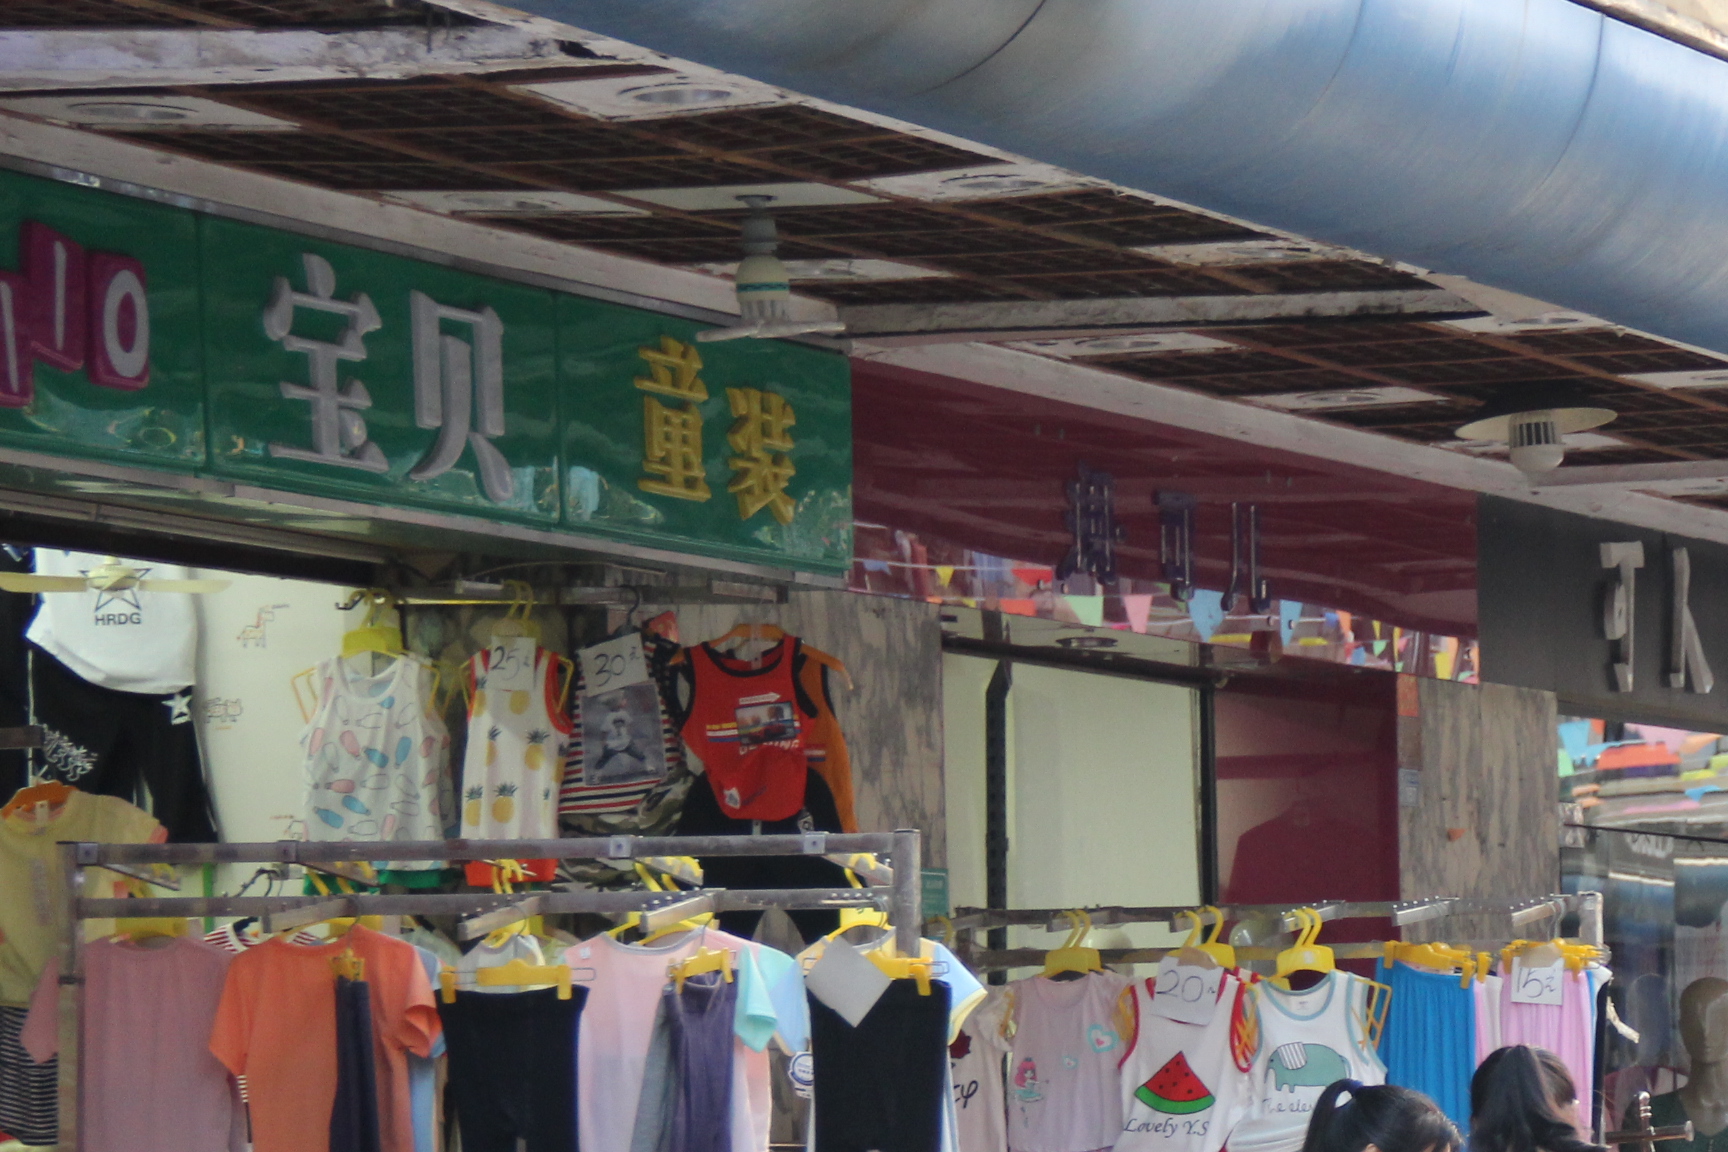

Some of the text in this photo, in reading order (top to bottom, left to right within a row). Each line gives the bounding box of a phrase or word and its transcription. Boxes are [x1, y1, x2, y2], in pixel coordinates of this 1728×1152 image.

[263, 251, 797, 526] 宝贝 童装
[95, 612, 142, 627] HRDG
[1123, 1116, 1179, 1139] Lovely
